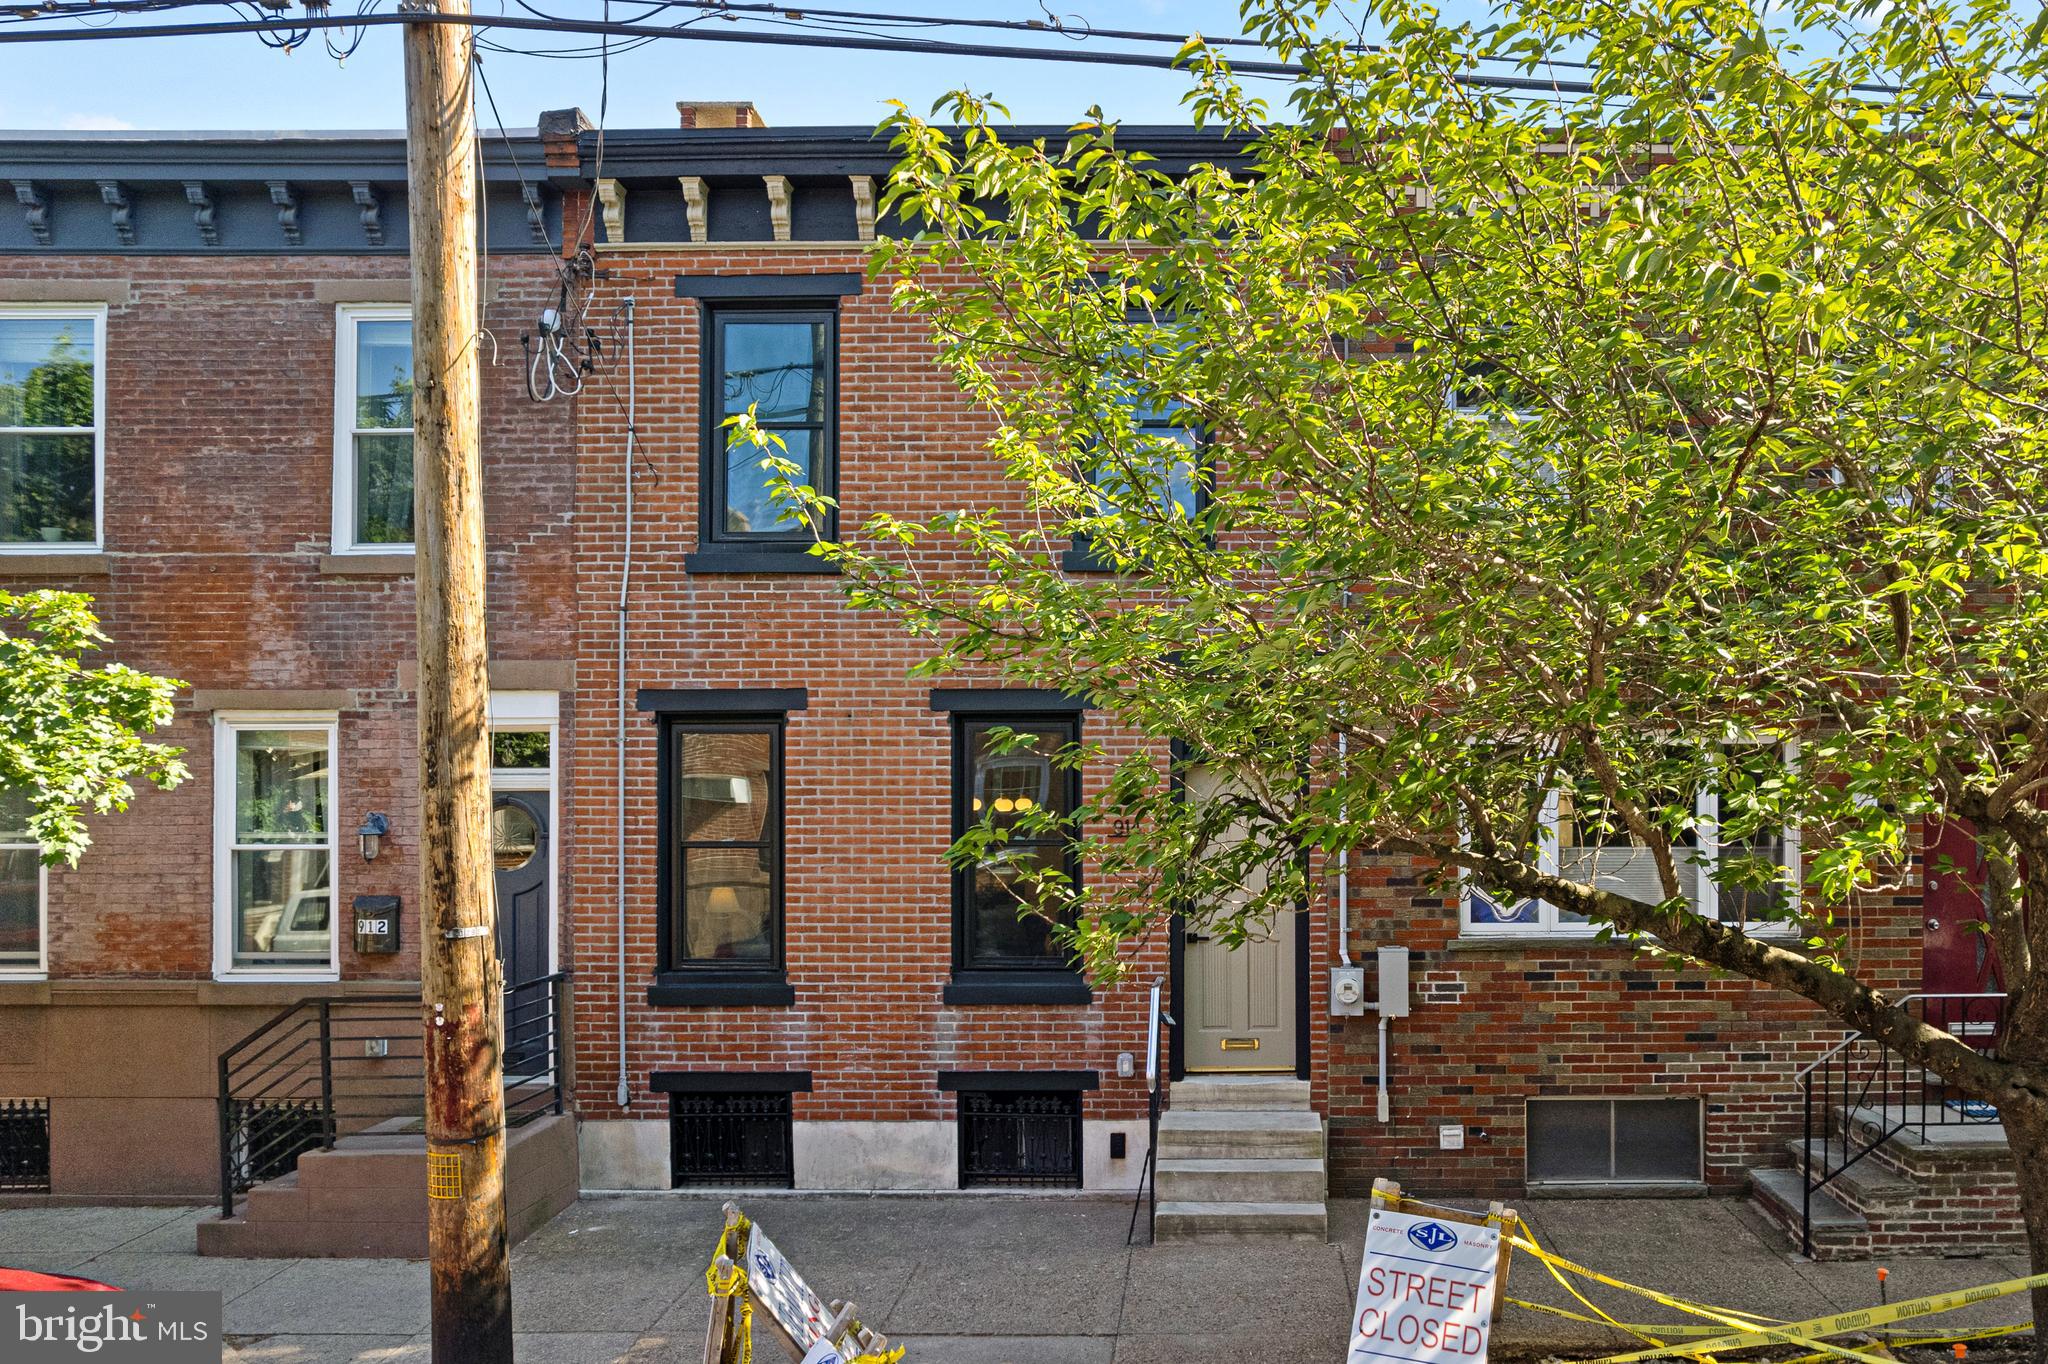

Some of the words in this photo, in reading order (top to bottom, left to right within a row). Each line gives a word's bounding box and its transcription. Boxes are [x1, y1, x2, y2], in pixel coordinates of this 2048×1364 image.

[358, 920, 387, 934] 912
[1373, 1225, 1404, 1235] CONCRETE
[1416, 1228, 1454, 1245] SJL
[1367, 1267, 1487, 1314] STREET
[1358, 1308, 1483, 1356] CLOSED
